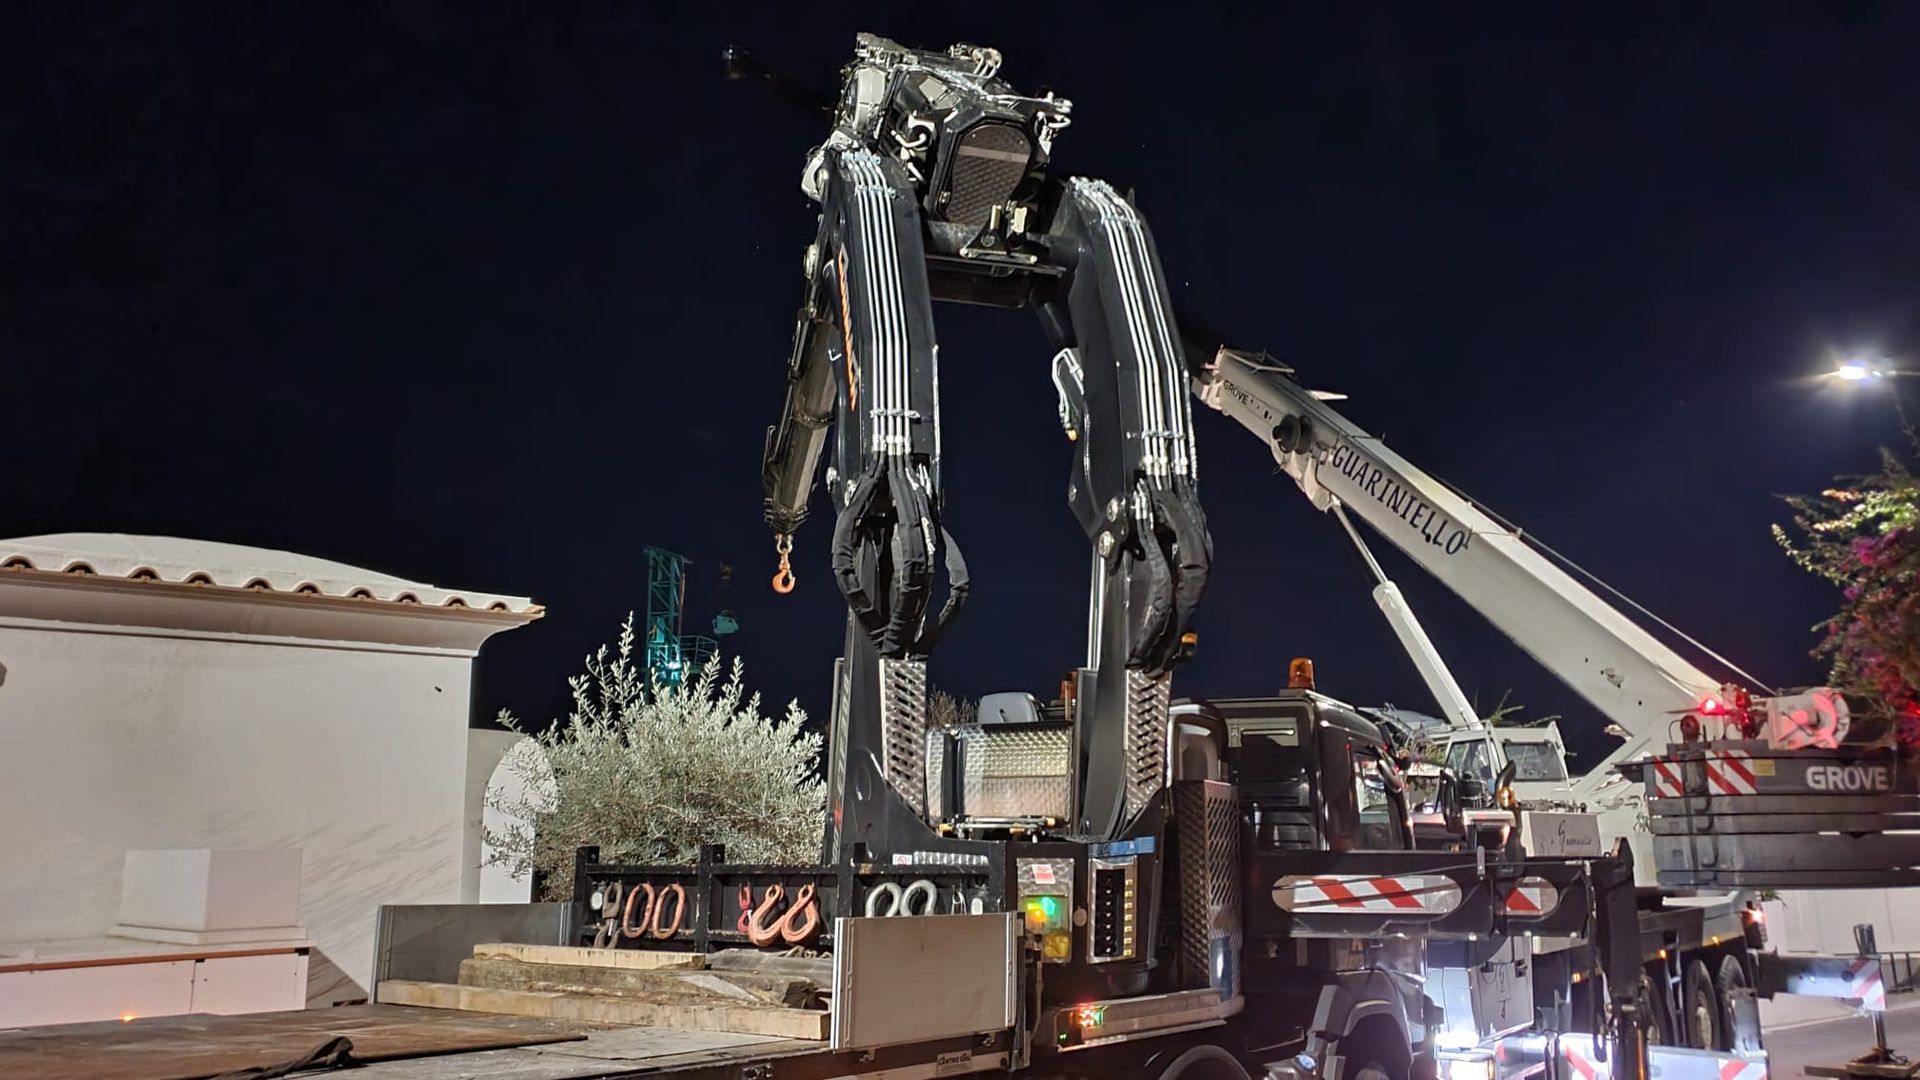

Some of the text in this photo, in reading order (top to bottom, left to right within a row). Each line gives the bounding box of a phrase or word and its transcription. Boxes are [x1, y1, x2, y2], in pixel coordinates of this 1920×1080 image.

[1223, 379, 1249, 405] GROVE
[1332, 444, 1465, 556] GUARINIELLO
[1806, 766, 1889, 790] GROVE
